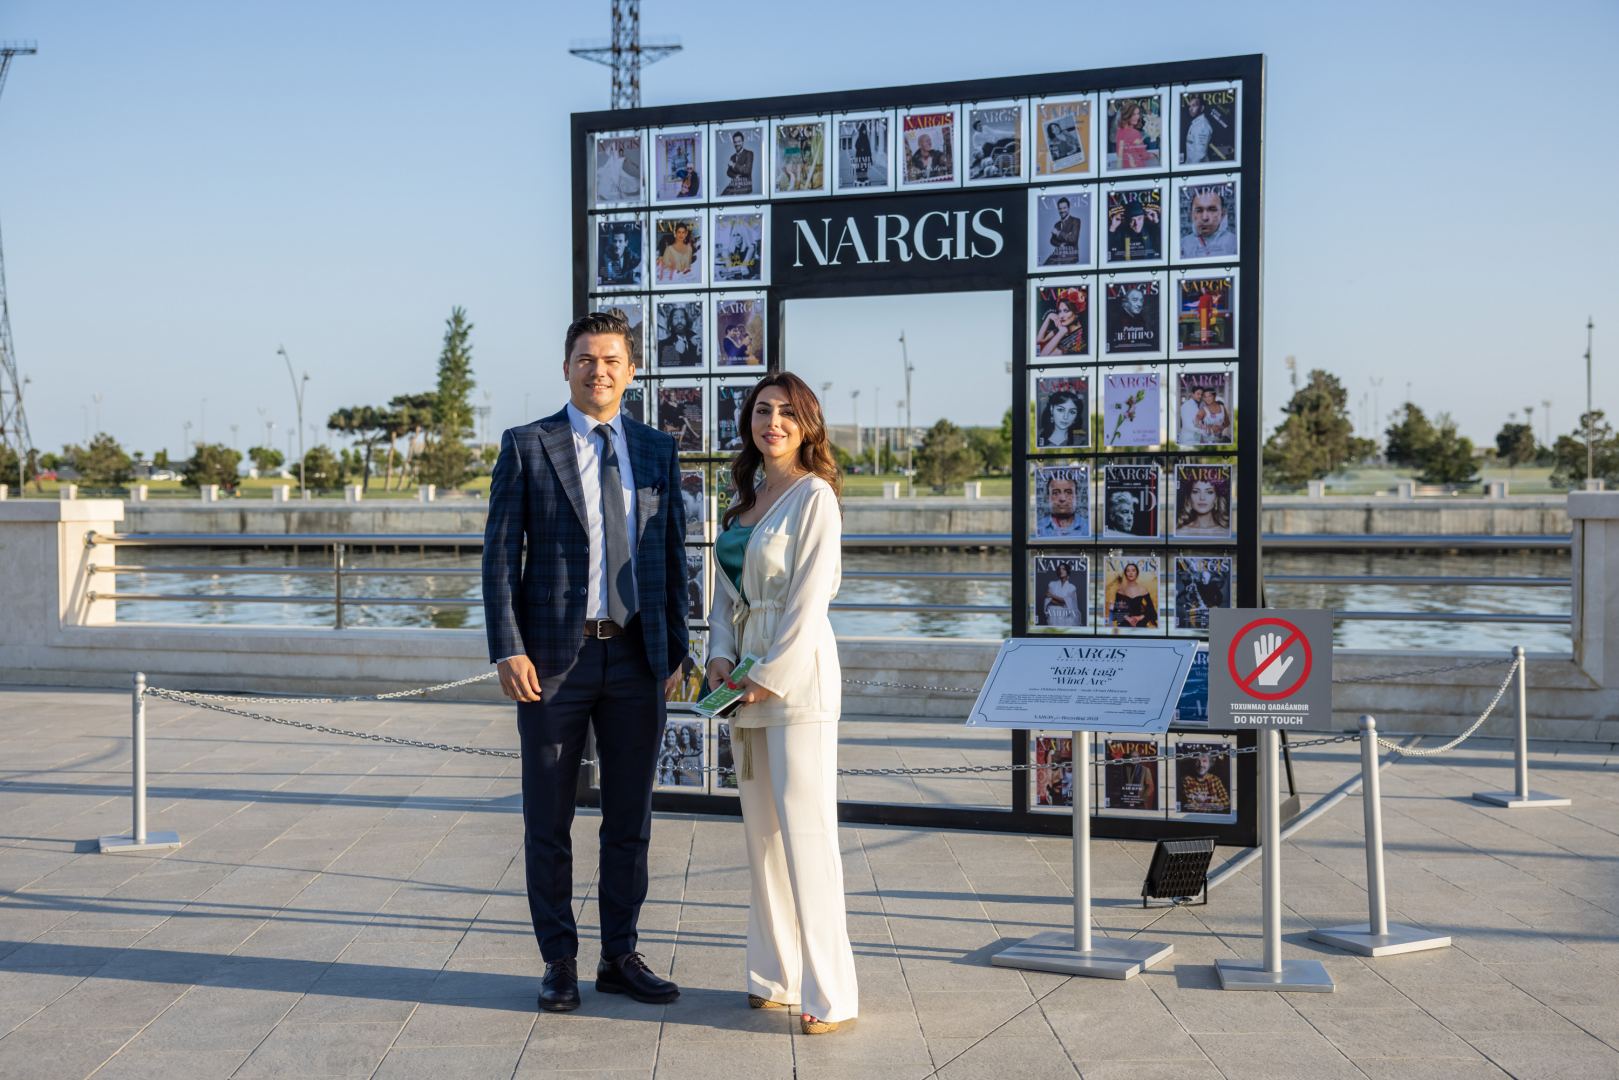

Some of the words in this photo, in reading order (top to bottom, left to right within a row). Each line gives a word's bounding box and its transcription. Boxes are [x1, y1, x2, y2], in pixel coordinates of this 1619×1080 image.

[1183, 92, 1234, 110] NRGIS
[905, 113, 951, 128] NARGIS
[1183, 186, 1233, 200] NARGIS
[1041, 196, 1089, 210] NAGIS
[793, 207, 1004, 267] NARGIS
[1108, 374, 1158, 388] NARGIS
[1038, 469, 1087, 481] NARGIS
[1107, 467, 1157, 480] NARGIS
[1179, 467, 1229, 480] NARGIS
[1058, 647, 1128, 659] NARGIS
[1230, 703, 1266, 711] TOXUNMAQ
[1234, 715, 1247, 724] DO
[1249, 715, 1269, 724] NOT
[1271, 715, 1303, 725] TOUCH
[1108, 741, 1157, 755] NARGIS
